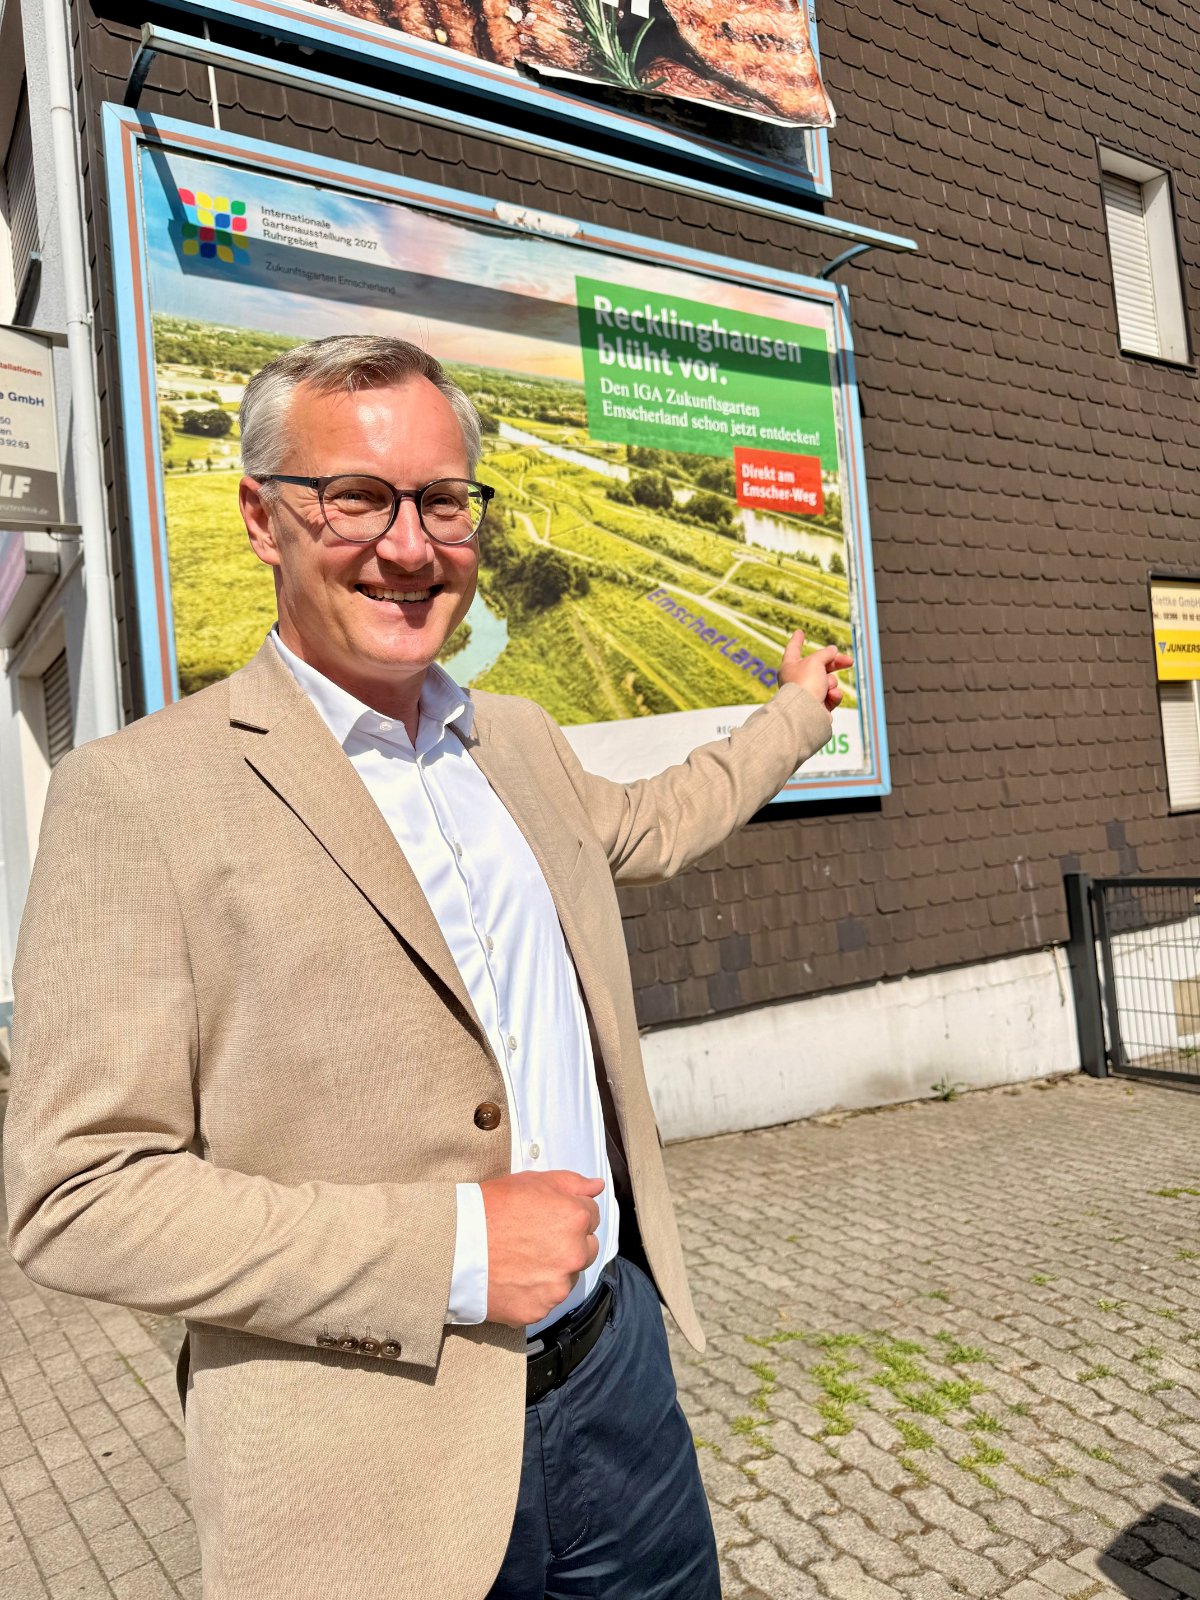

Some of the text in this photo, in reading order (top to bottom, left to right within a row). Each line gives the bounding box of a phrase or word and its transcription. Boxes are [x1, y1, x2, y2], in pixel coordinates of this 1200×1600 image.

[261, 206, 331, 229] Internationale
[262, 217, 378, 250] Gartenausstellung 2027
[263, 229, 319, 249] Ruhrgebiet
[265, 261, 396, 294] Zukunftsgarten Emscherland
[594, 295, 802, 364] Recklinghausen
[597, 333, 728, 386] blüht vor.
[8, 391, 45, 407] GmbH
[600, 377, 760, 418] Den IGA Zukunftsgarten
[602, 399, 821, 446] Emscherland schon jetzt entdecken!
[0, 471, 32, 499] LF
[741, 463, 795, 483] Direkt am
[742, 481, 817, 506] Emscher-Weg
[1167, 643, 1200, 653] JUNKERS
